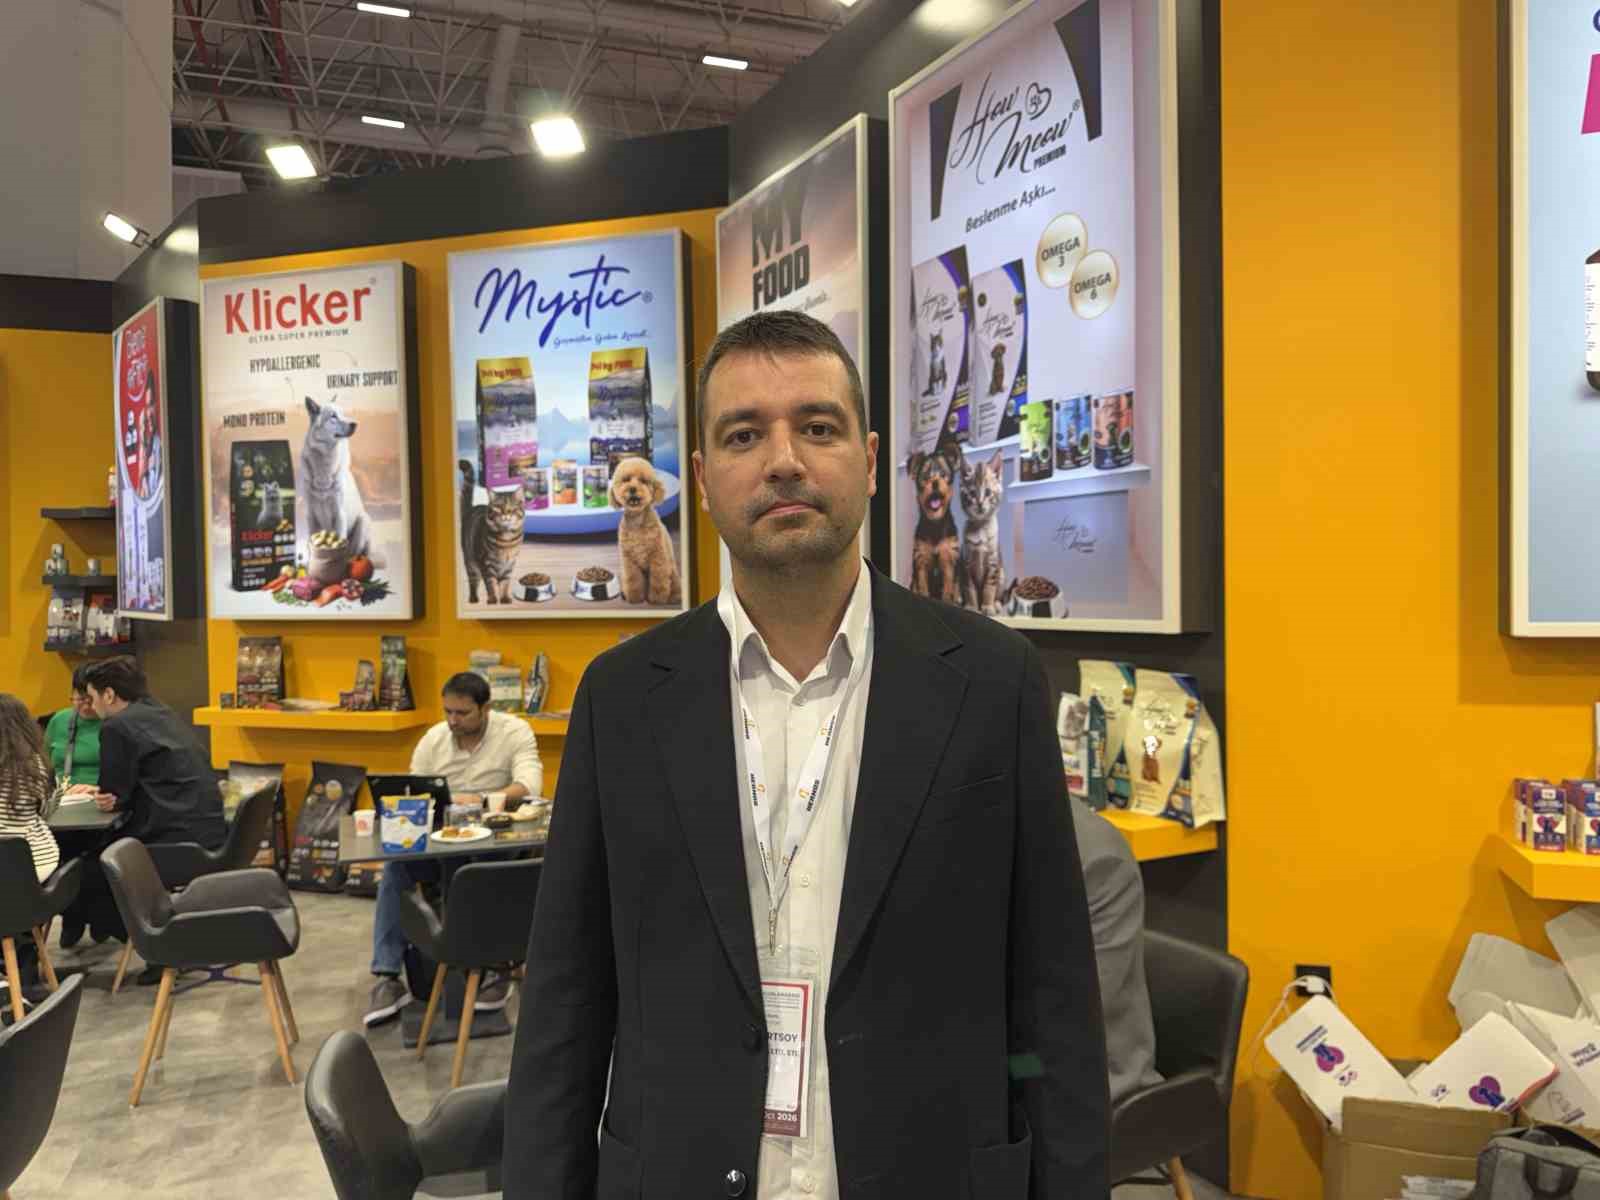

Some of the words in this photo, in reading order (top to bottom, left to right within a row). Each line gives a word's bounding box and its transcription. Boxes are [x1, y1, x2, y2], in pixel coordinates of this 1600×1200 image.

[965, 198, 1018, 233] Beslenme
[1041, 237, 1081, 261] OMEGA
[1058, 256, 1065, 267] 3
[752, 244, 810, 311] FOOD
[1074, 272, 1112, 294] OMEGA
[474, 254, 642, 347] Mystic
[1090, 289, 1097, 300] 6
[224, 283, 371, 335] Klicker
[308, 328, 349, 338] PREMIUM
[250, 354, 321, 373] HYPOALLERGENIC
[327, 373, 361, 389] URINARY
[363, 370, 398, 387] SUPPORT
[223, 413, 247, 429] MONO
[249, 411, 285, 427] PROTEIN
